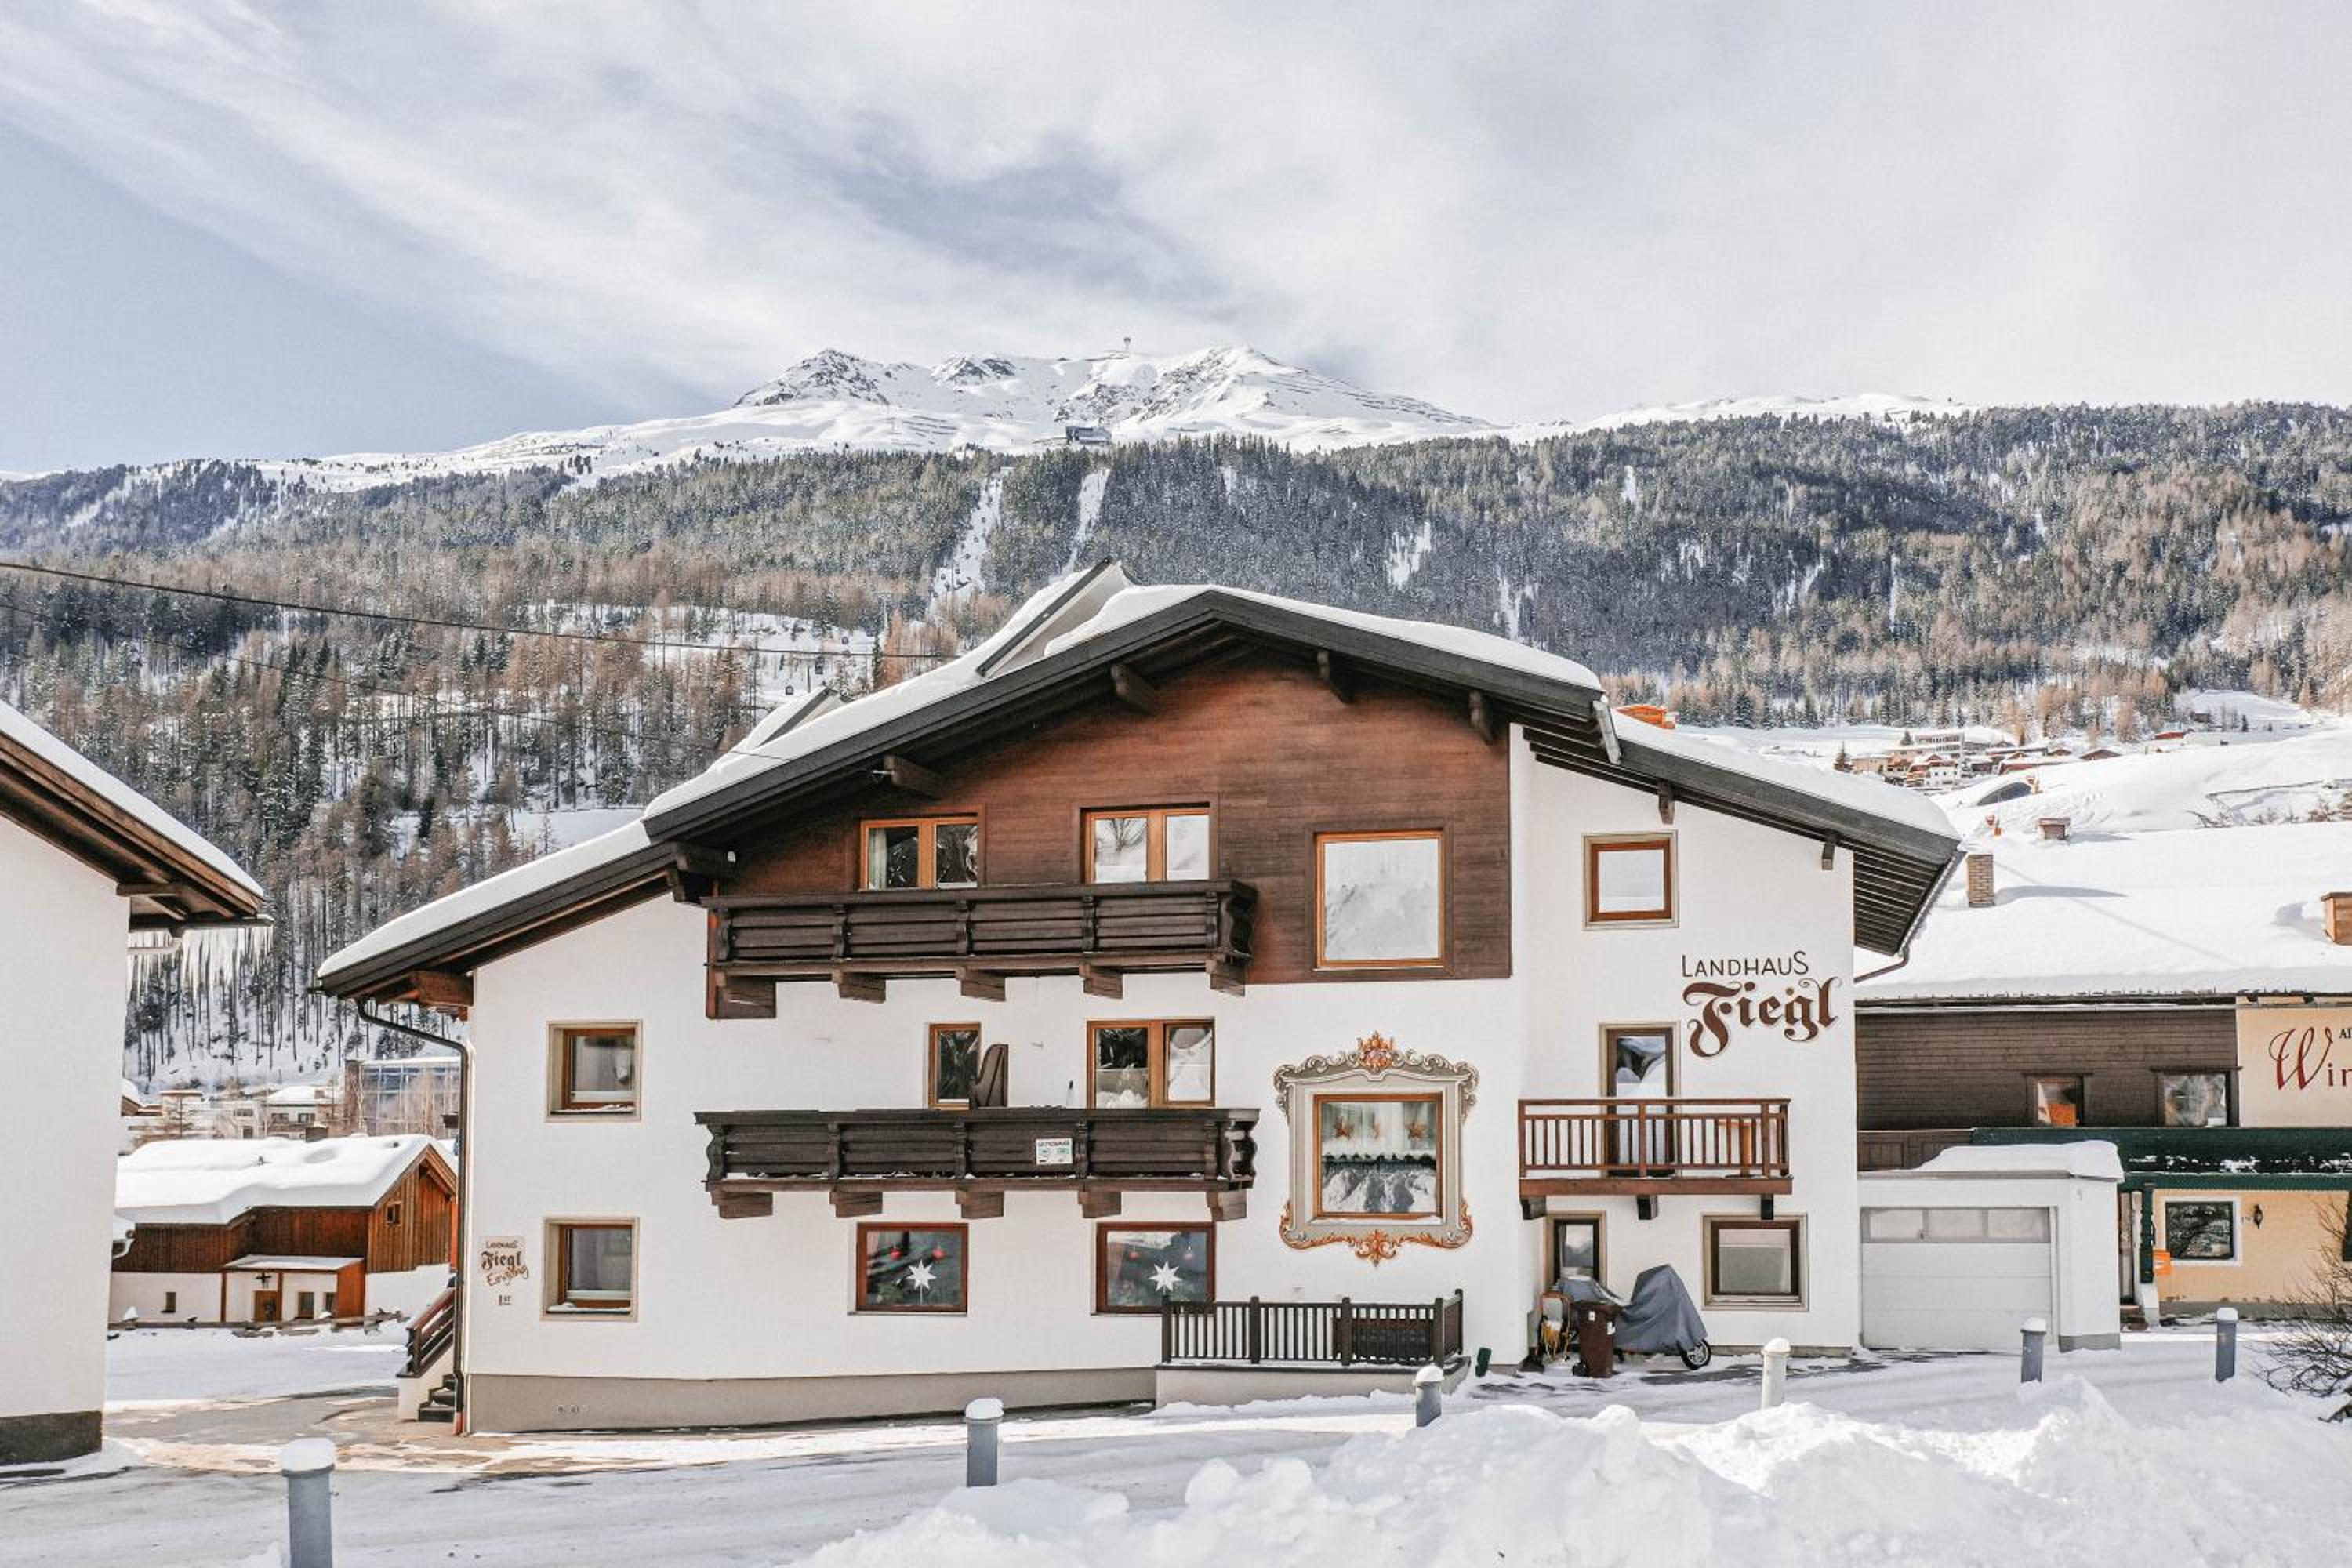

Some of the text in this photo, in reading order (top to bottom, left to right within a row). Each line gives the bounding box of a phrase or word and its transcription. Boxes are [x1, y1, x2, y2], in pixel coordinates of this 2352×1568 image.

[1682, 950, 1809, 978] LANDHAUS
[1682, 977, 1842, 1058] Fiegl
[481, 1250, 522, 1270] Fiegl
